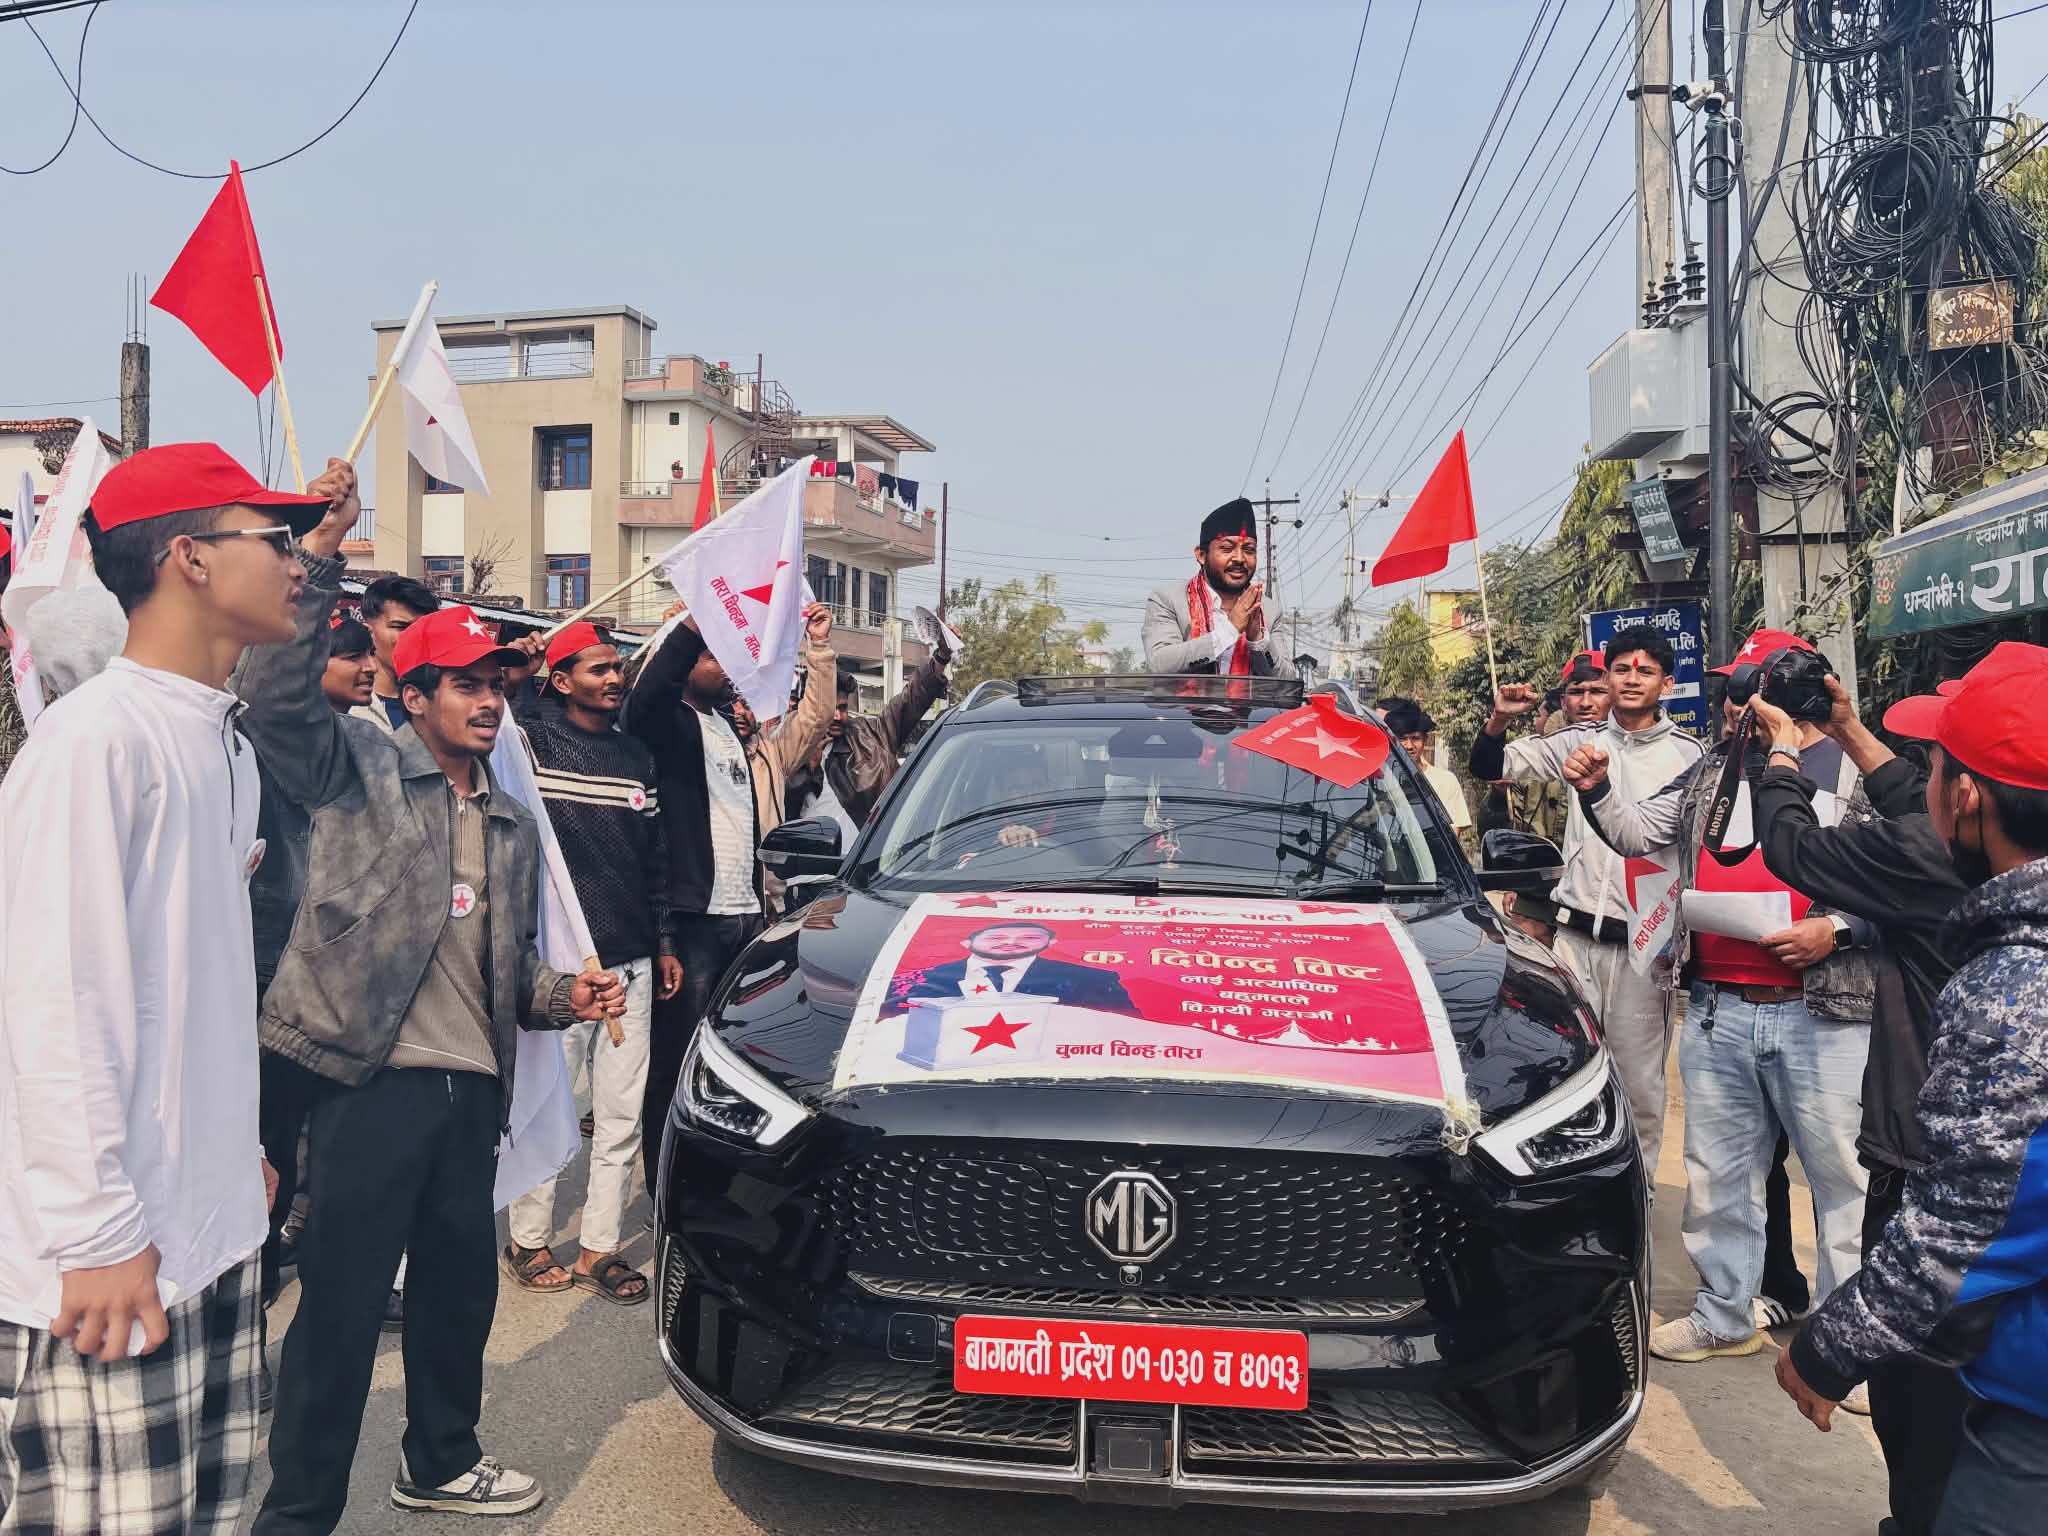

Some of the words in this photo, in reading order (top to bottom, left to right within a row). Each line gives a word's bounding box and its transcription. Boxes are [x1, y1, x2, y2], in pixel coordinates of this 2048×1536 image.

[1709, 796, 1730, 837] Canon
[1082, 950, 1135, 965] क.
[1055, 1044, 1104, 1059] चुनाव
[1096, 1181, 1168, 1253] MG
[965, 1328, 1051, 1376] बागमती
[1060, 1331, 1116, 1382] प्रदेश
[1121, 1346, 1204, 1388] ०१-०३०
[1213, 1351, 1233, 1386] च
[1239, 1351, 1300, 1394] ४०१३
